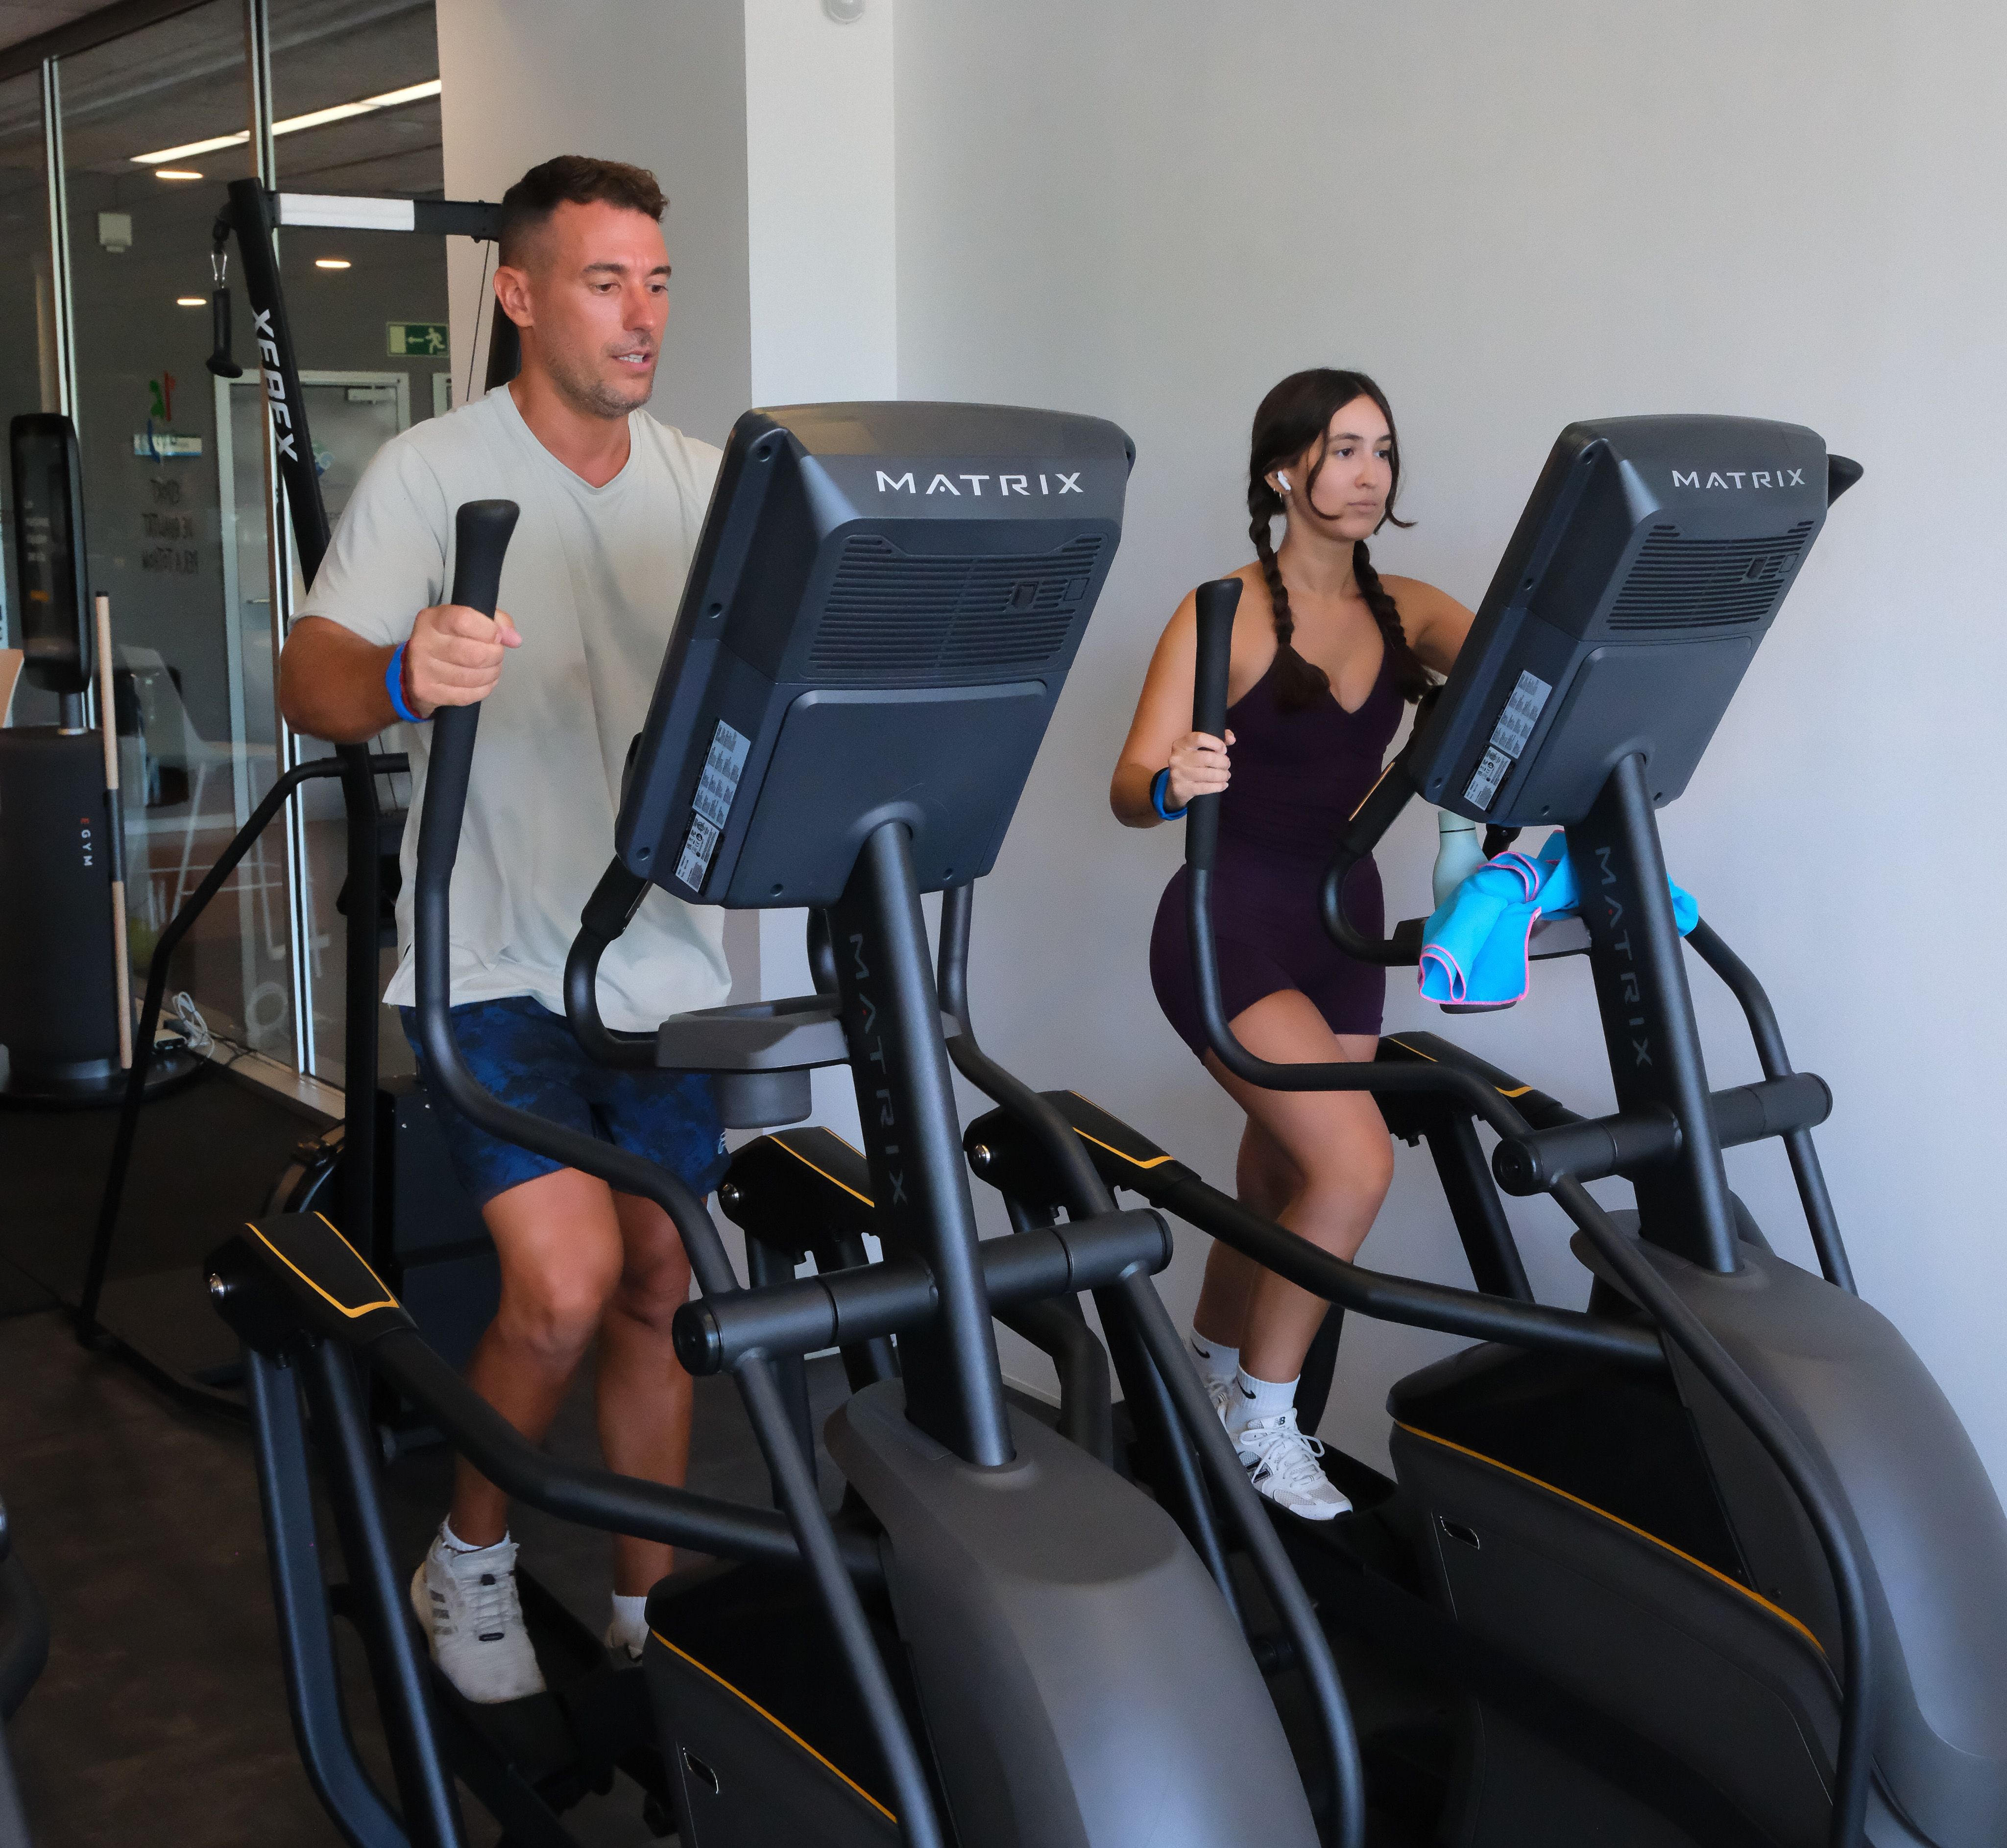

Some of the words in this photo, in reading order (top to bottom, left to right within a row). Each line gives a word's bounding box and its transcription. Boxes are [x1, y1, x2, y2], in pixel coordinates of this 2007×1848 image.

[252, 309, 298, 463] XEBEX
[876, 471, 1084, 496] MATRIX
[1672, 468, 1806, 489] MATRIX
[80, 817, 93, 866] EGYM
[1595, 846, 1652, 1067] MATRIX
[849, 934, 908, 1205] MATRIX
